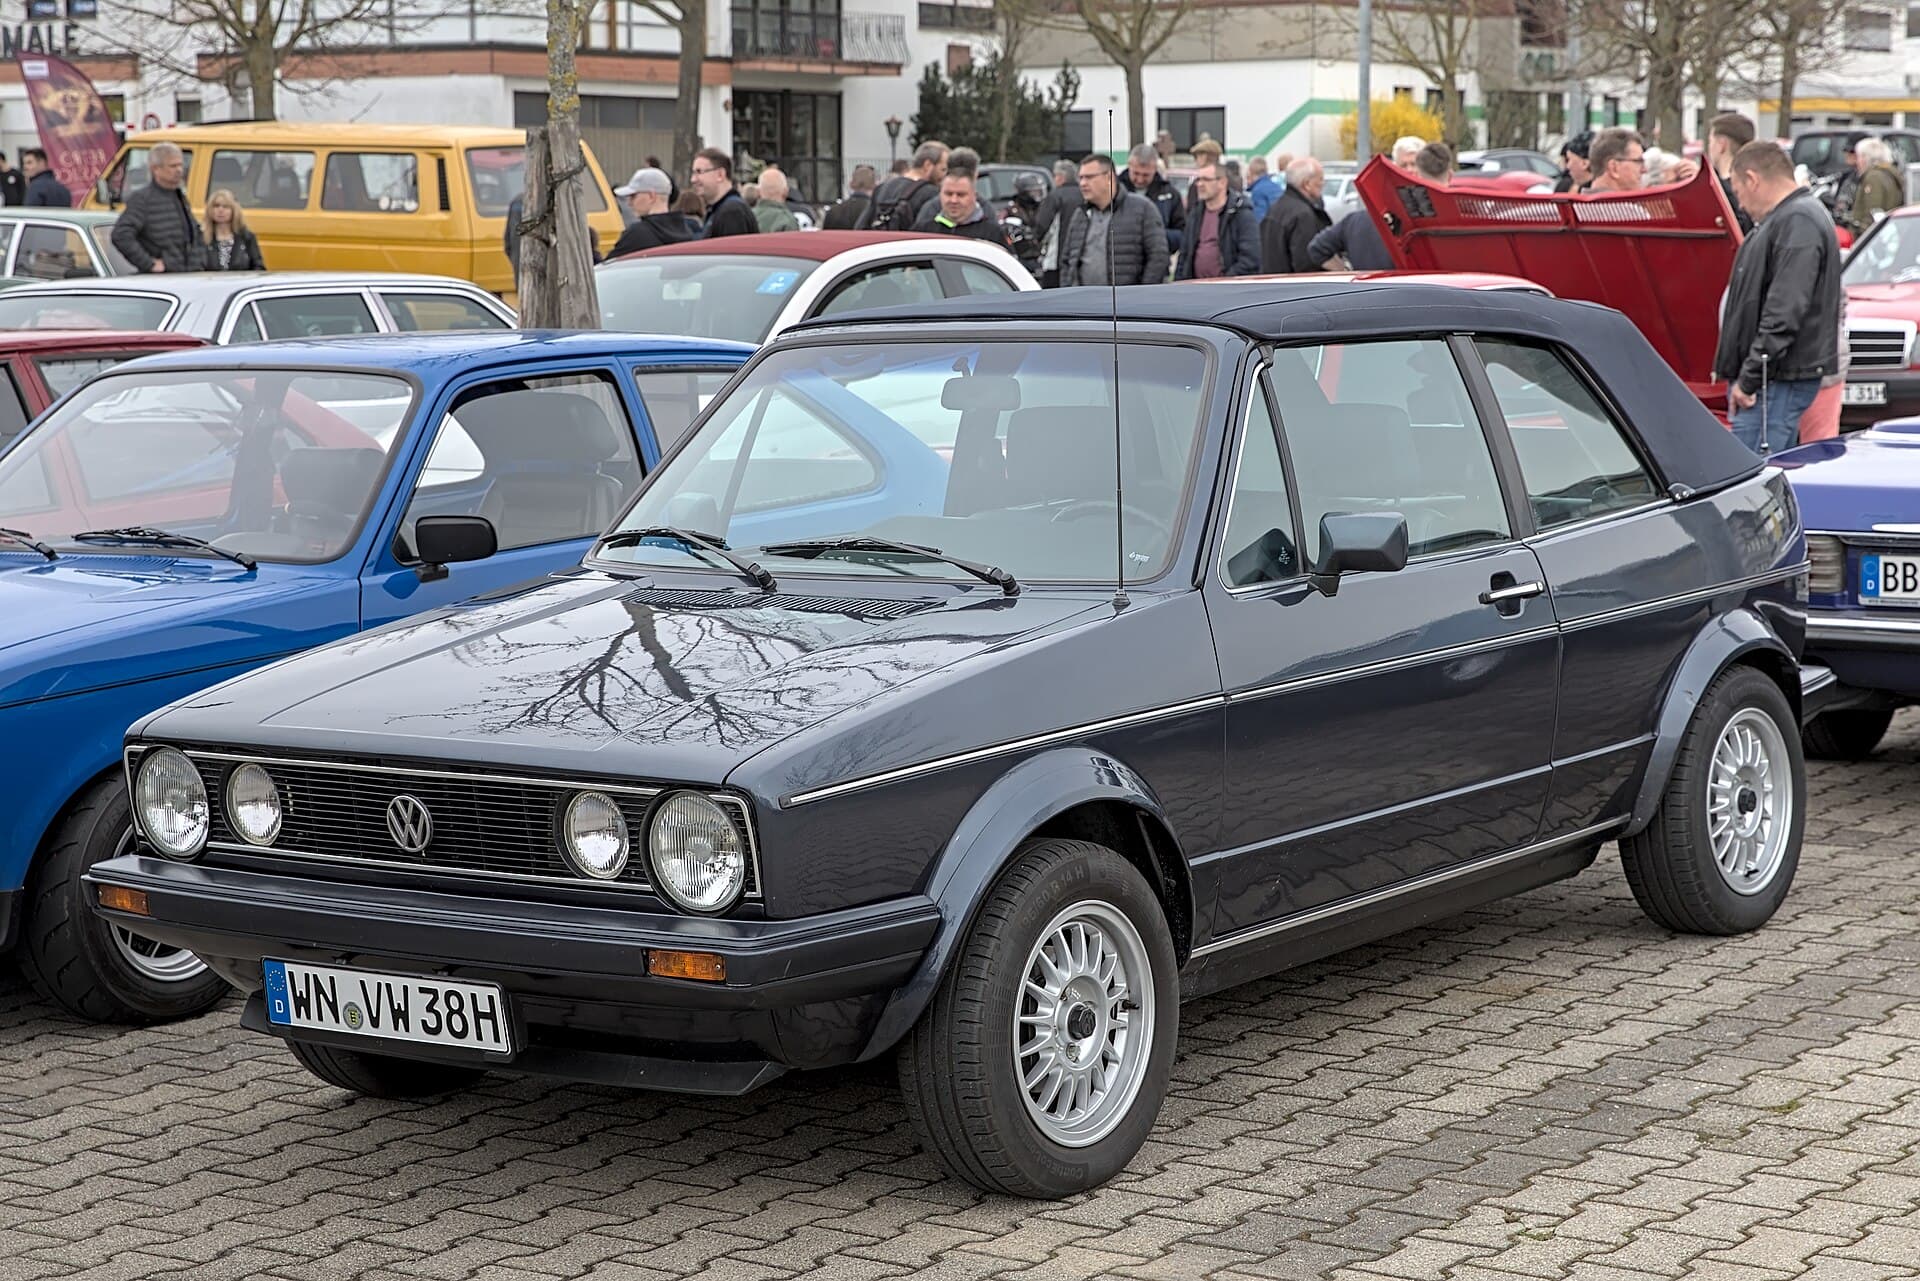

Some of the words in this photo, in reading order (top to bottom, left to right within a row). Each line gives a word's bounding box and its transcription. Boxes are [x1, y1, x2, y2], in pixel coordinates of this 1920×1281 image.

[3, 24, 79, 57] MALE
[1866, 580, 1875, 590] D
[1883, 562, 1918, 592] BB
[275, 999, 285, 1014] D
[288, 970, 340, 1024] WN
